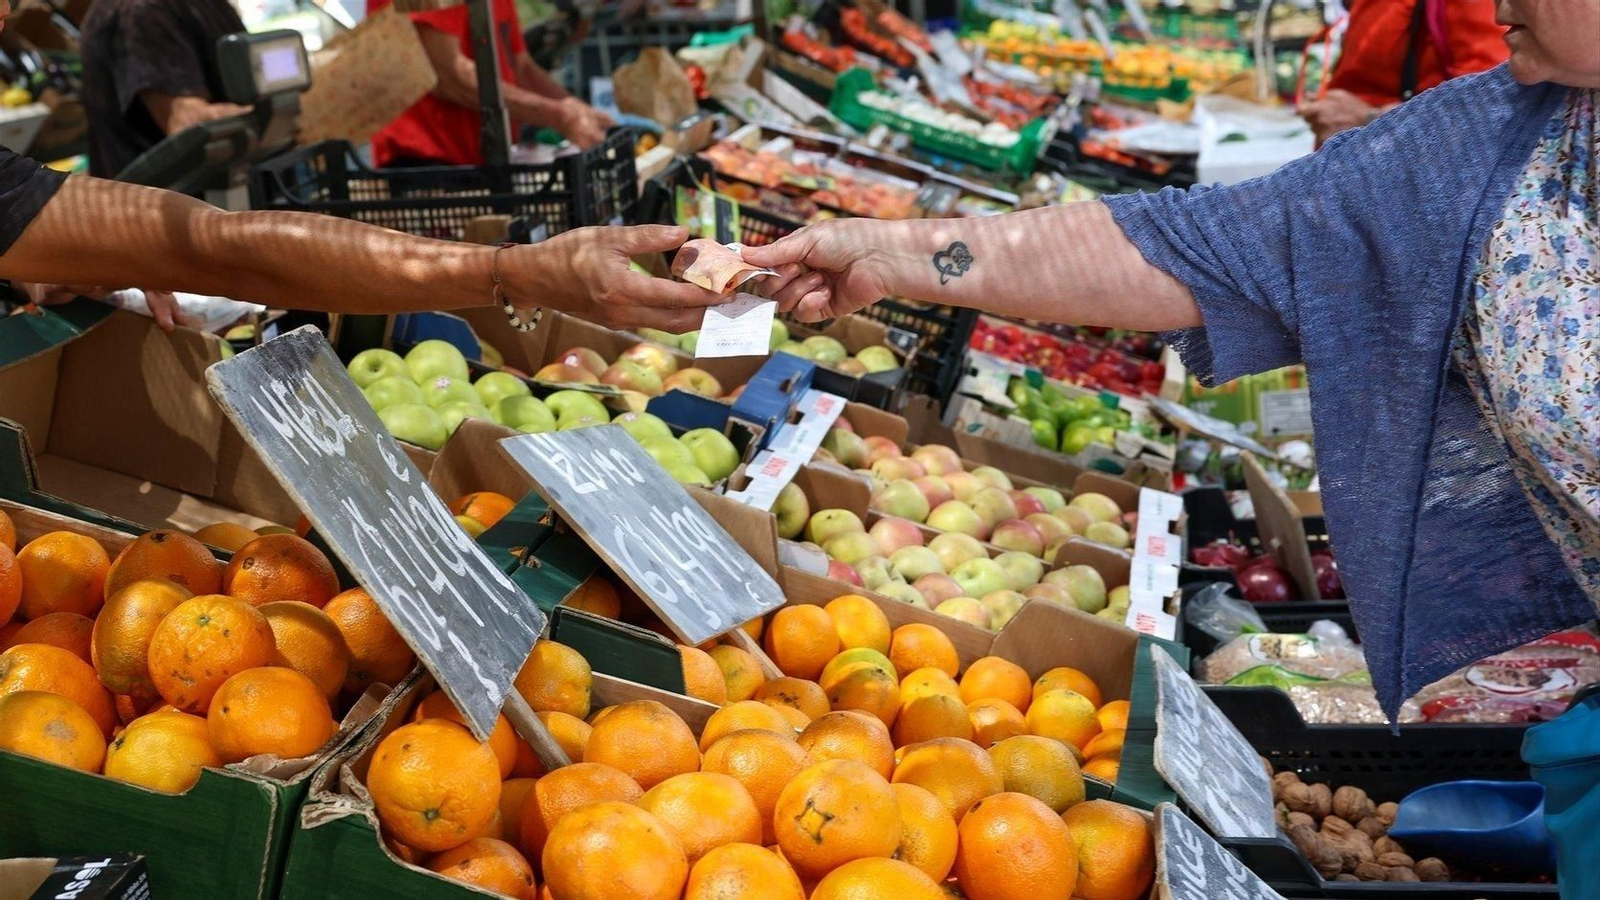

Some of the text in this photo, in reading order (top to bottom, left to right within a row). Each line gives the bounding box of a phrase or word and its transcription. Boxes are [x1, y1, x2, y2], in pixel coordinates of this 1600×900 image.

[377, 433, 409, 483] €
[613, 525, 678, 604] 6
[745, 581, 771, 606] €
